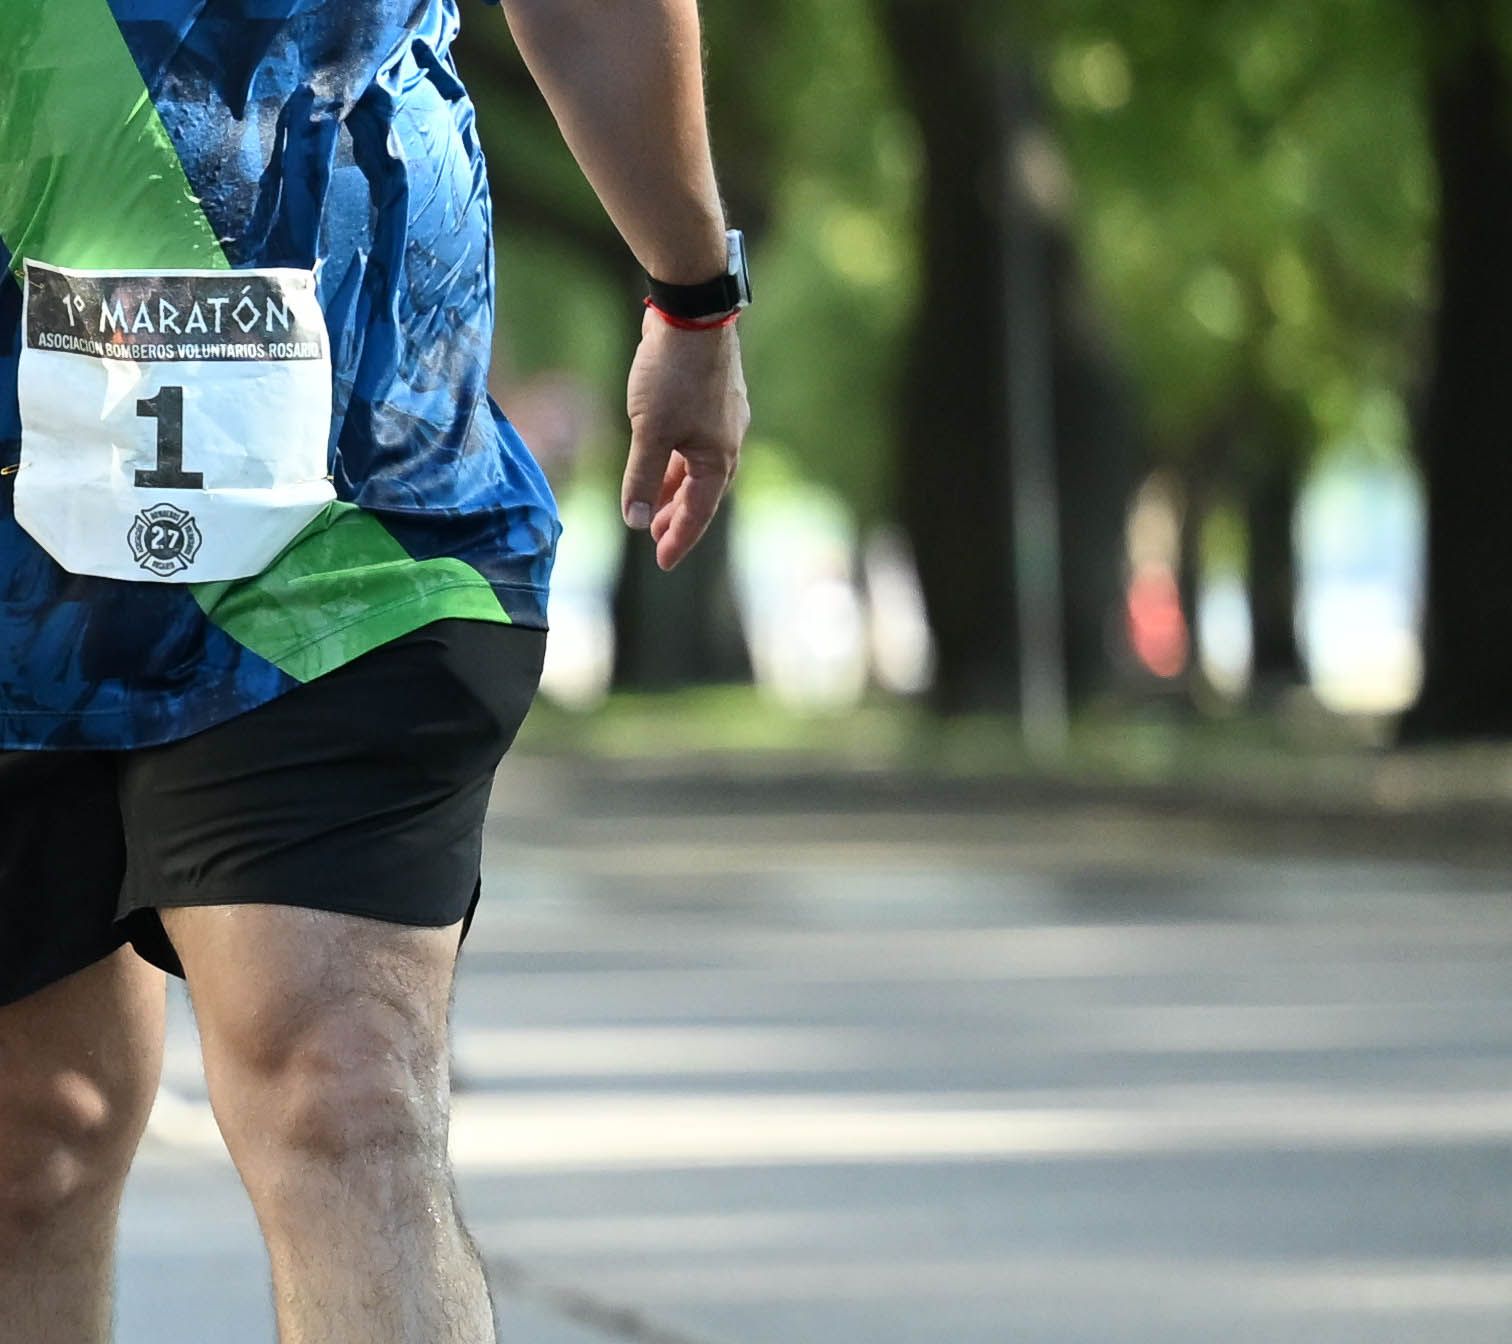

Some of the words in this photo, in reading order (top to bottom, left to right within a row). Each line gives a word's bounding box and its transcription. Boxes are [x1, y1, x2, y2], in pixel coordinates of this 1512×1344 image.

[98, 285, 292, 335] MARATÓN
[38, 332, 104, 356] ASOCIACIÓN
[105, 342, 175, 359] BOMBEROS
[176, 342, 264, 358] VOLUNTARIOS
[268, 342, 320, 358] ROSARIO
[134, 386, 204, 489] 1
[151, 525, 181, 550] 27
